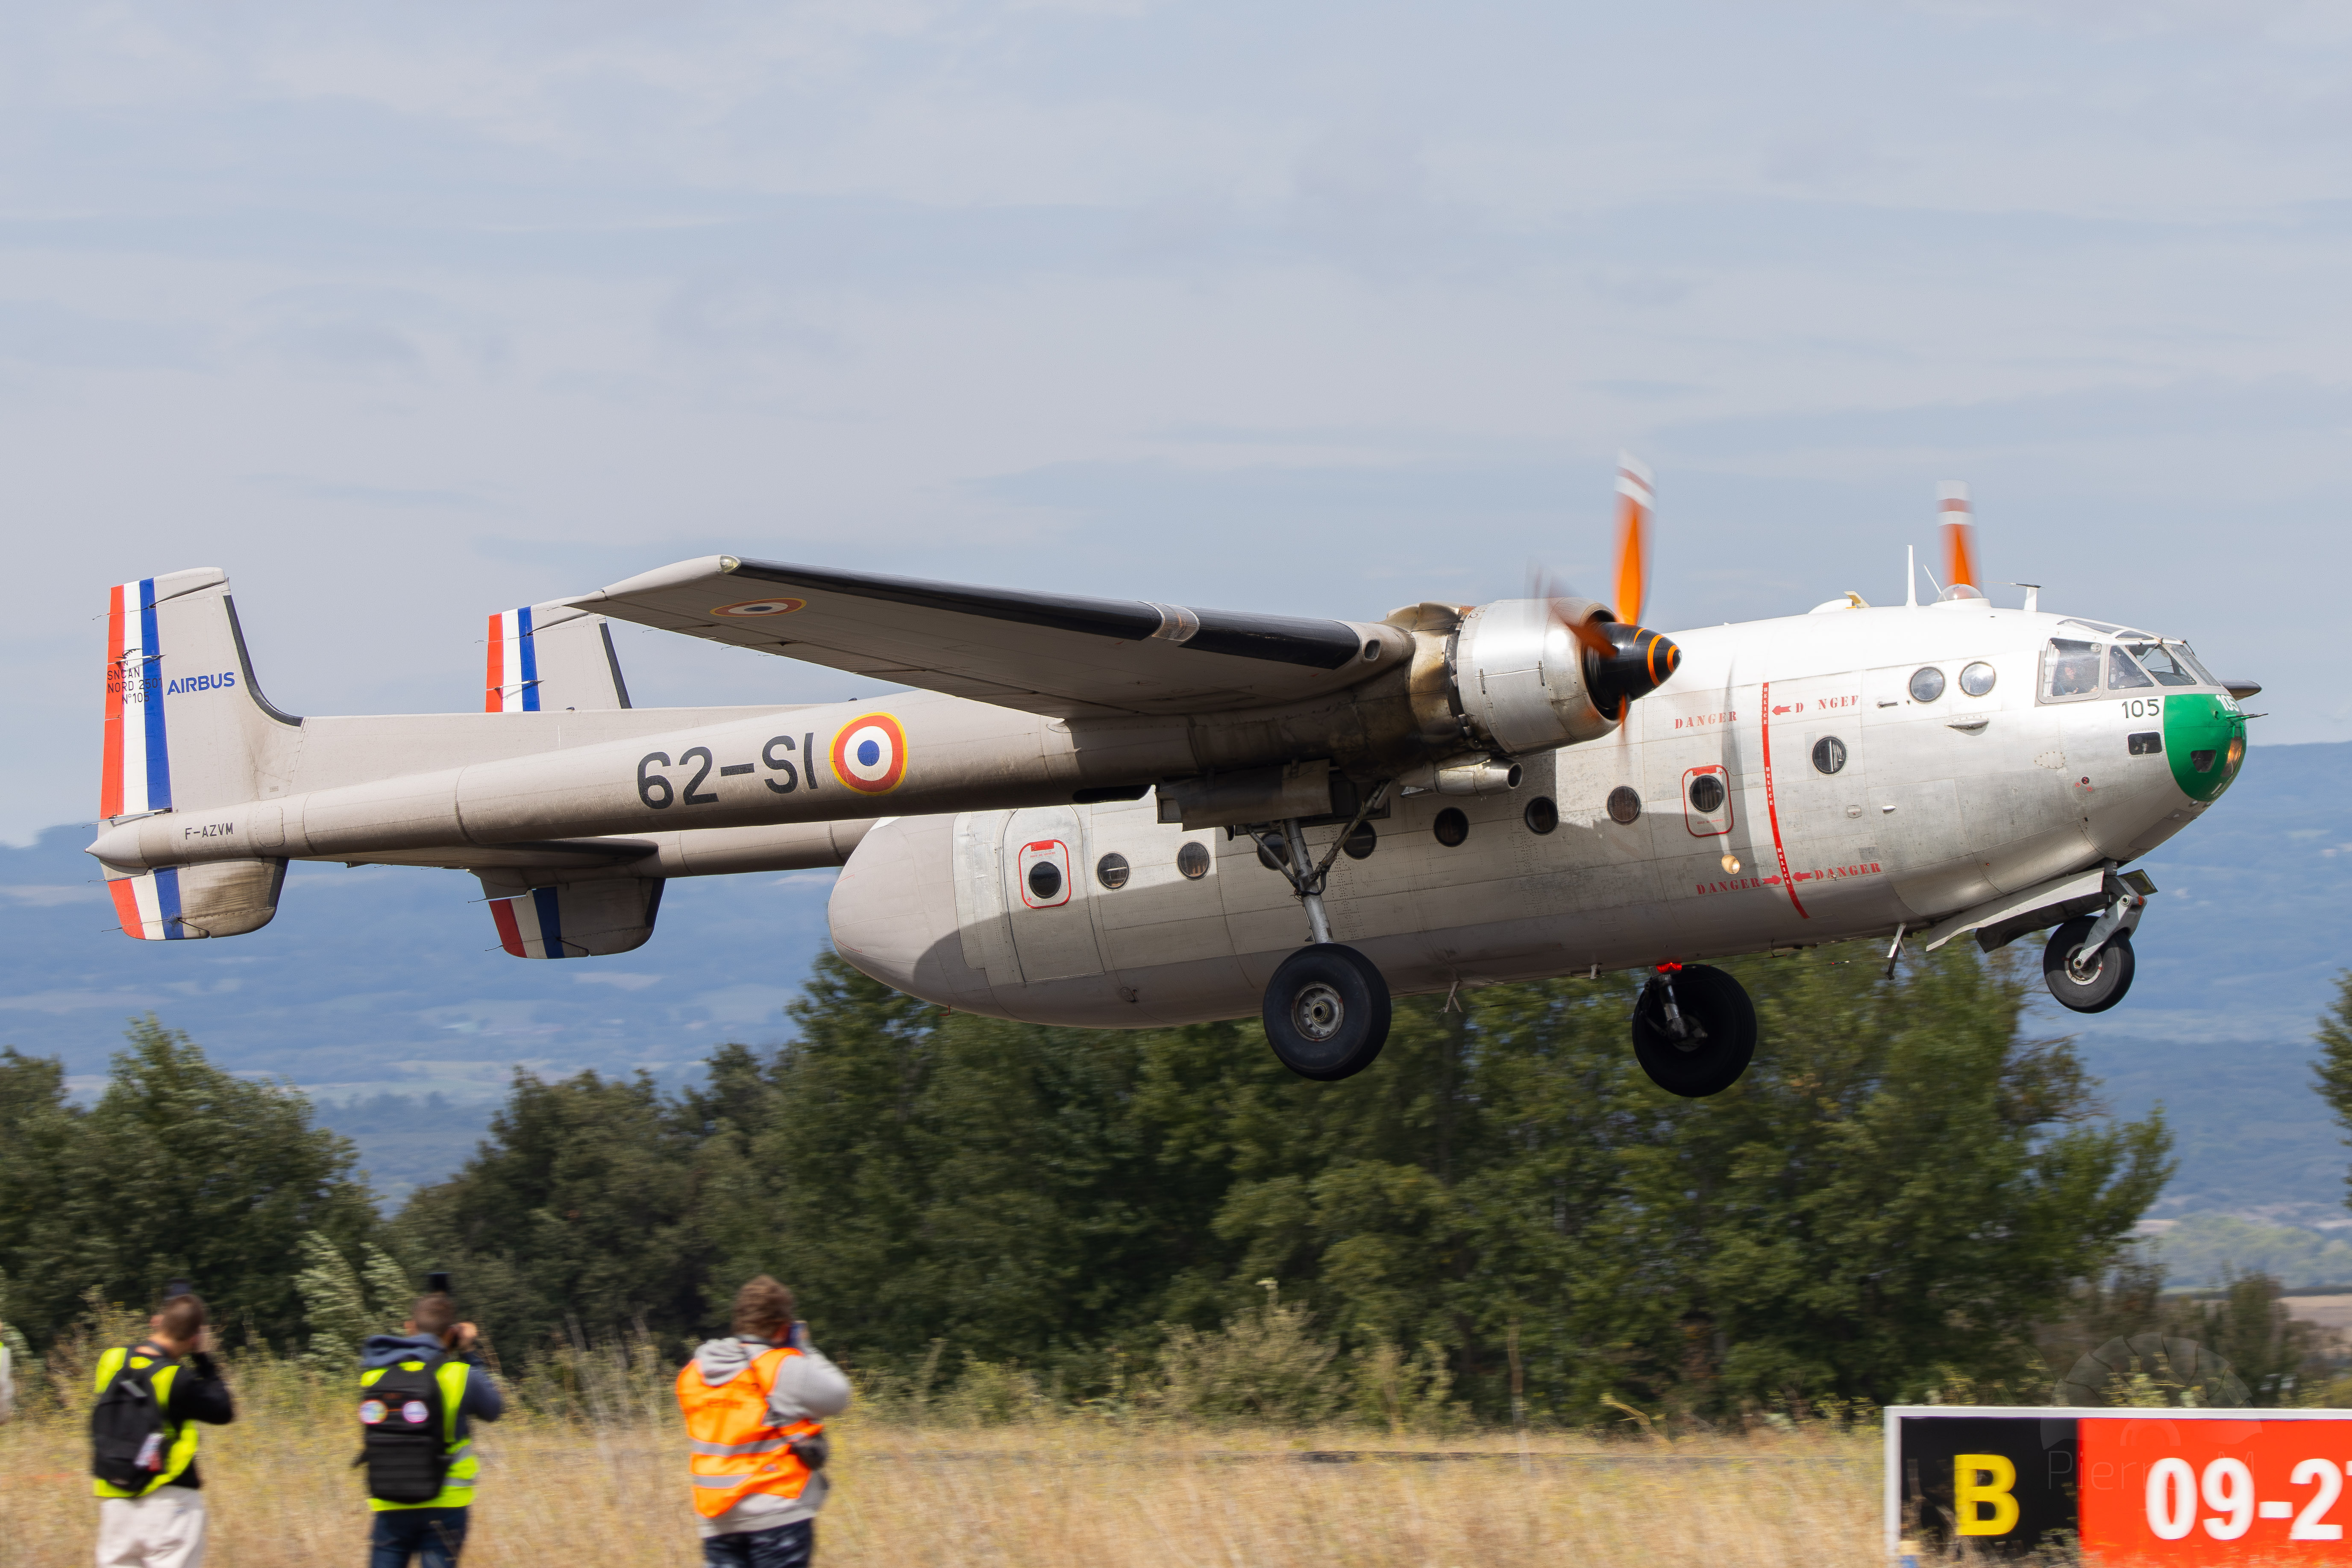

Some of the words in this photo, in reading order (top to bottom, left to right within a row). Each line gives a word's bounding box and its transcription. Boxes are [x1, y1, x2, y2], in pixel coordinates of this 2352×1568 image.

[107, 667, 140, 680] SNCAN
[108, 681, 134, 693] NORD
[167, 672, 235, 695] AIRBUS
[122, 691, 150, 704] N°105
[1796, 695, 1859, 713] DNGE
[2215, 694, 2240, 712] 105
[2122, 699, 2159, 718] 105
[1675, 711, 1736, 729] DANGER
[637, 732, 819, 810] 62-SI
[185, 822, 233, 840] F-AZVM
[1777, 848, 1790, 884] HELICE
[1814, 862, 1882, 880] DANGER
[1696, 878, 1761, 894] DANGER
[1954, 1454, 2020, 1536] B
[2146, 1457, 2352, 1541] 09-2
